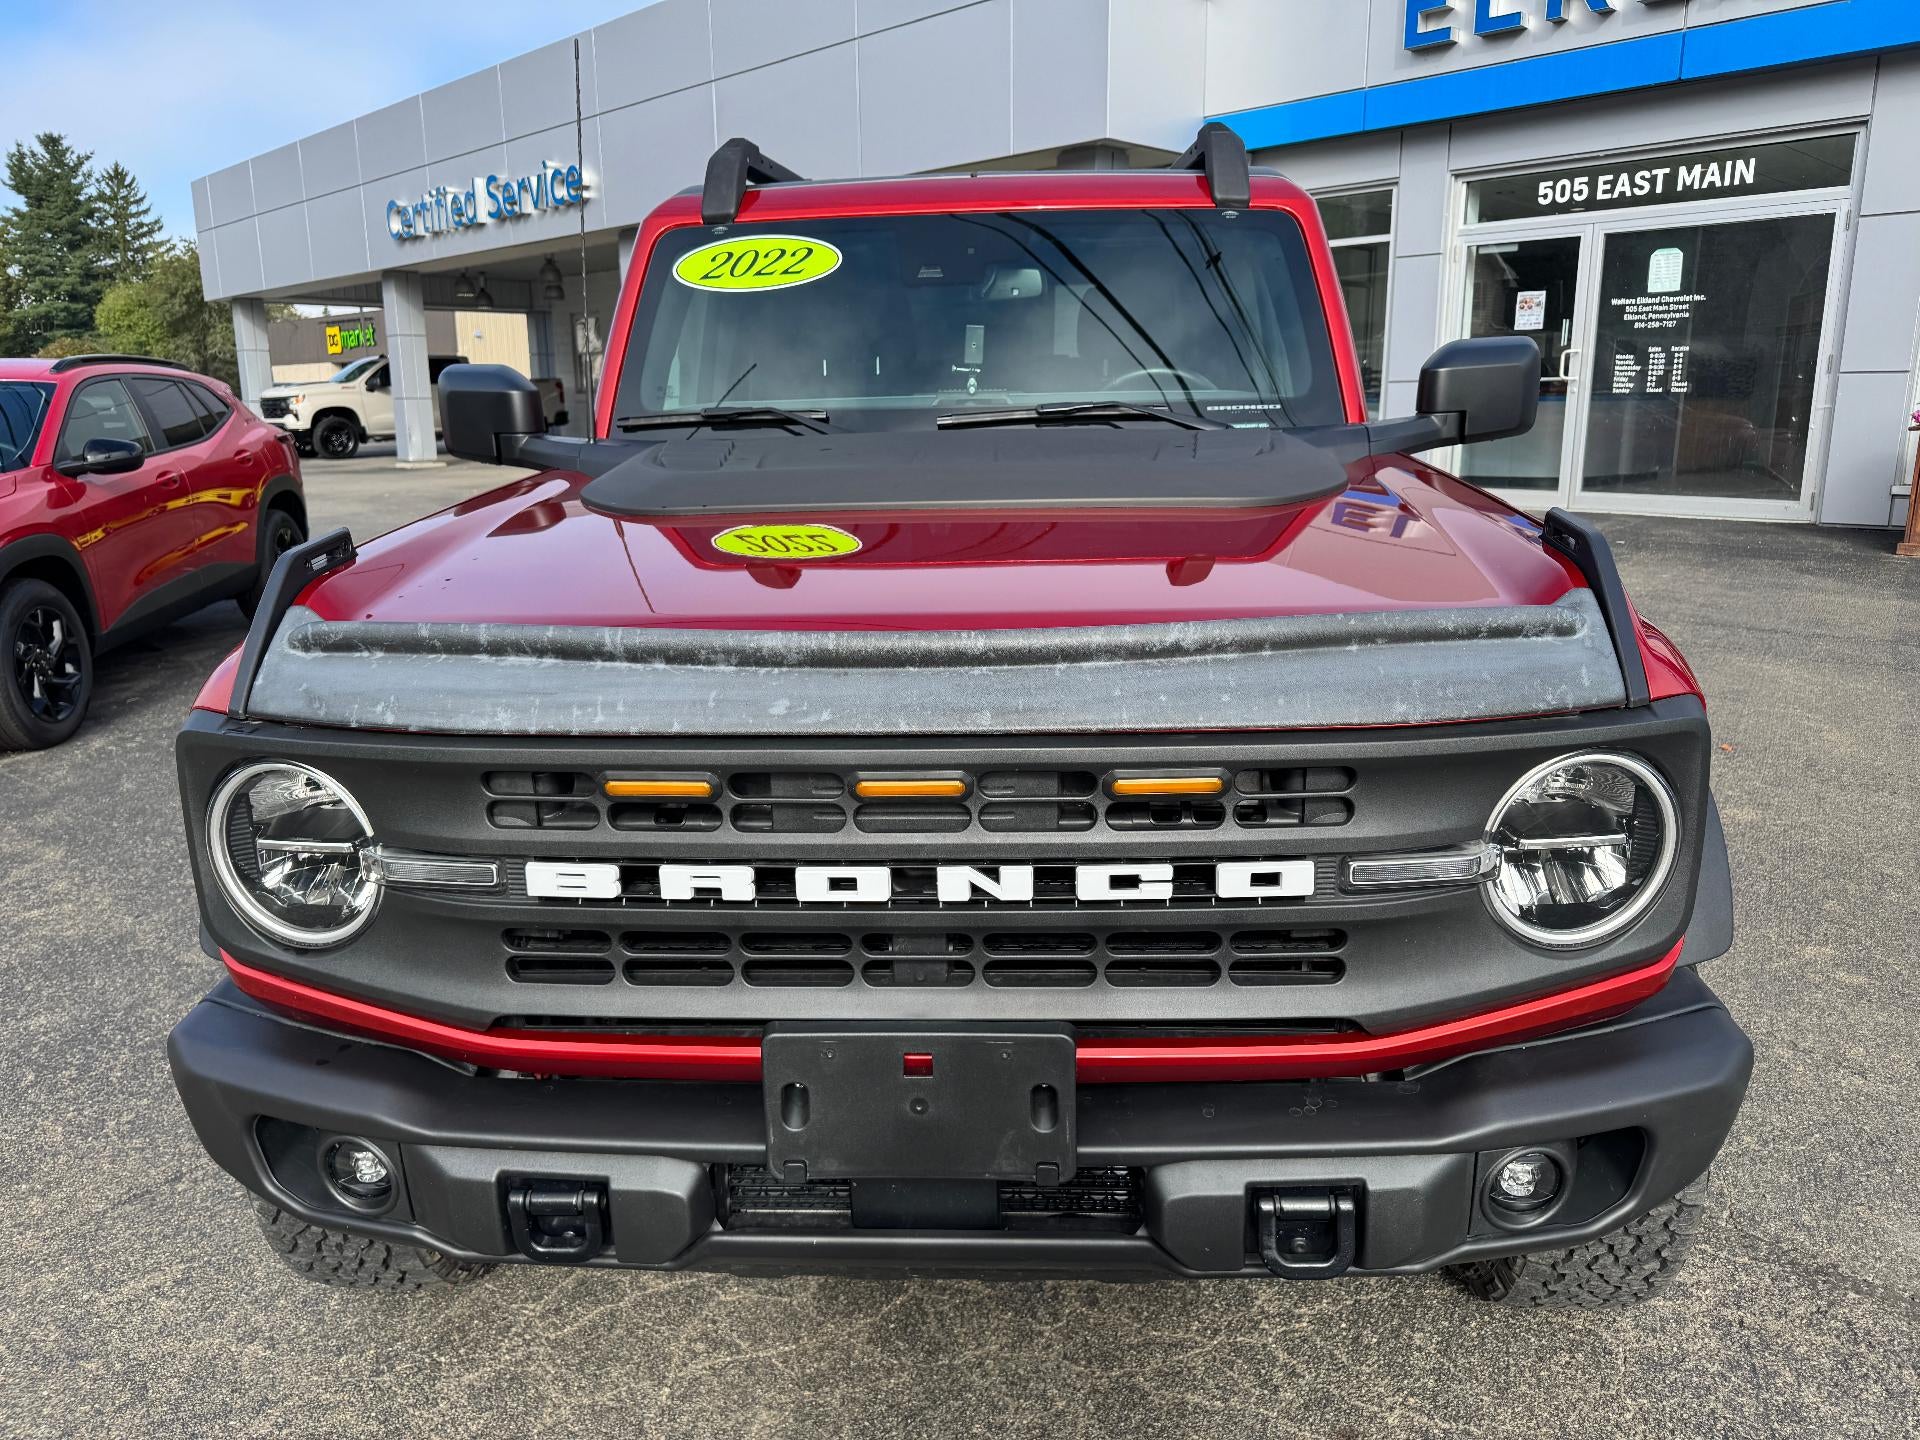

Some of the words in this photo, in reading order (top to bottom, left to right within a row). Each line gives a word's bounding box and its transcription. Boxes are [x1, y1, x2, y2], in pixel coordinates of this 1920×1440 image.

[1537, 176, 1589, 205] 505
[1596, 168, 1670, 200] EAST
[1676, 157, 1756, 192] MAIN
[387, 177, 483, 240] Certified
[486, 160, 585, 219] Service
[699, 247, 814, 280] 2022
[1636, 296, 1660, 304] Elkland
[1661, 294, 1693, 303] Chevrolet
[1648, 311, 1689, 320] Pennsylvania
[1669, 303, 1689, 311] Street
[525, 861, 1316, 903] BRONCO
